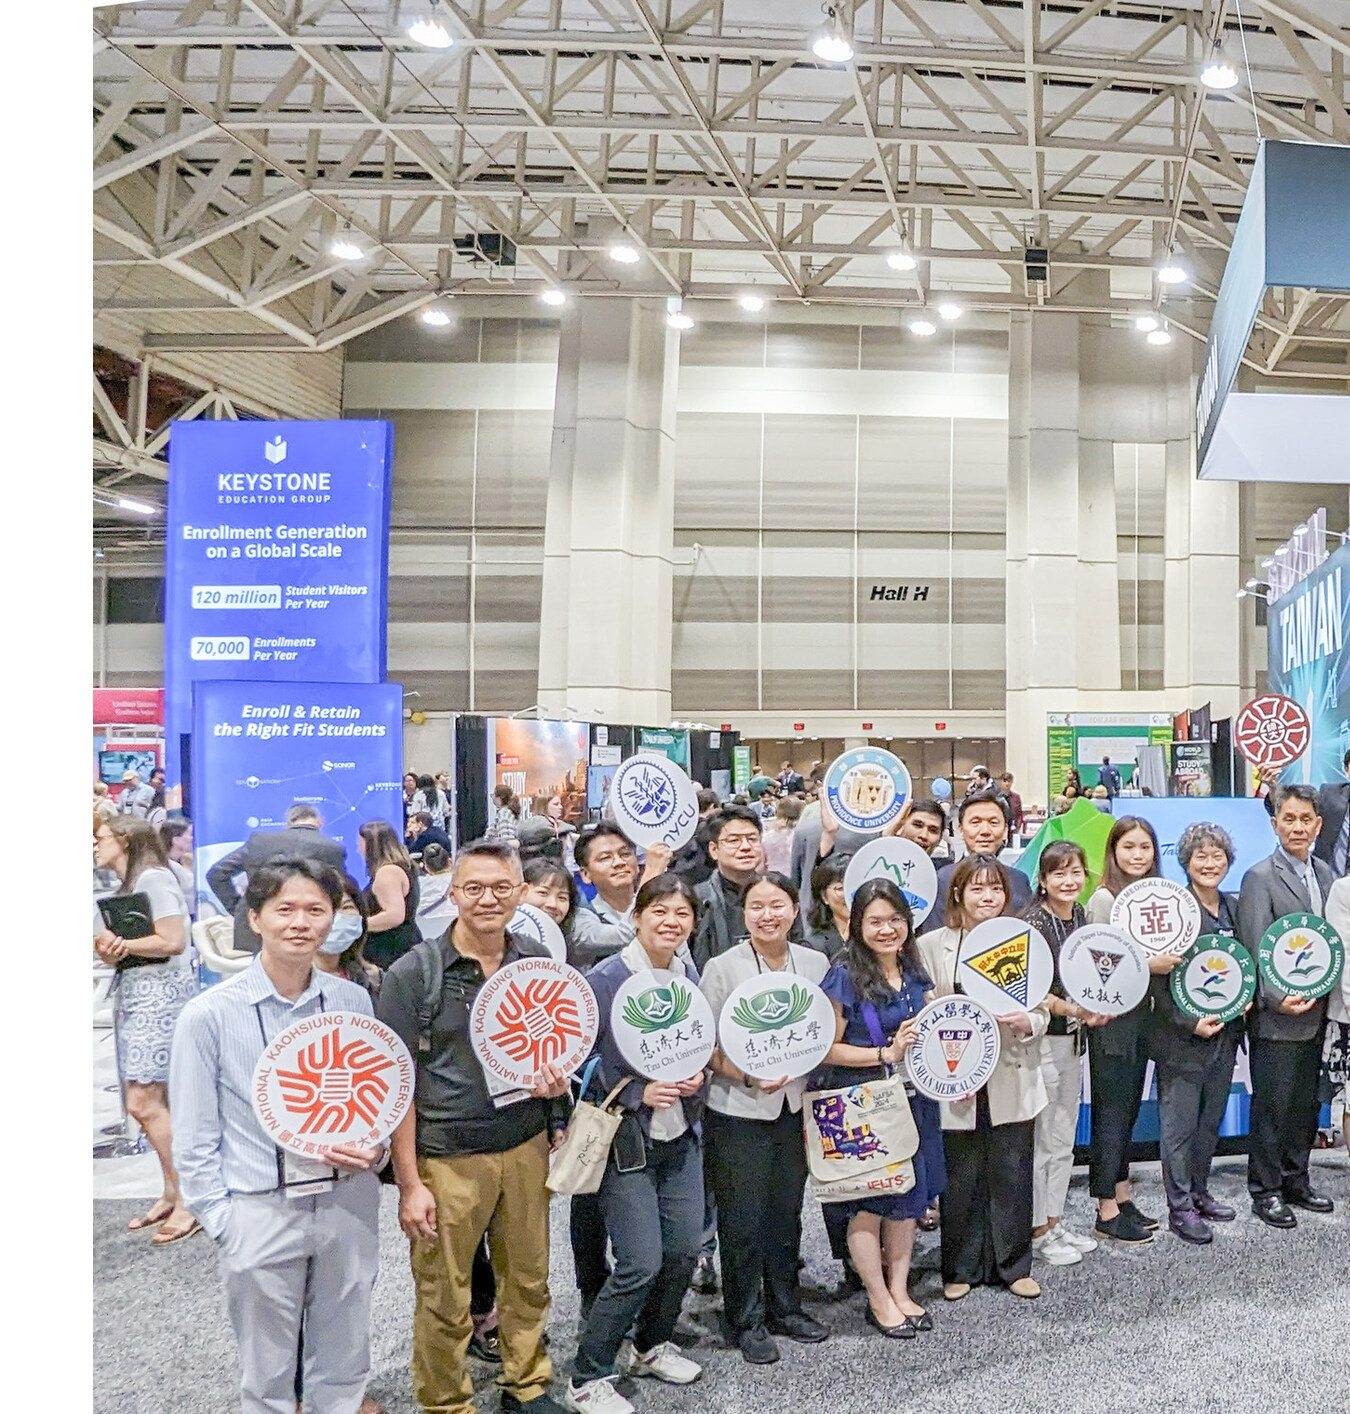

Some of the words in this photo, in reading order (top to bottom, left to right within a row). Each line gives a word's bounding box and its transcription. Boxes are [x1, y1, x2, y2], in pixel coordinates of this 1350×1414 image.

[218, 473, 331, 491] KEYSTONE
[218, 495, 285, 504] EDUCATION
[291, 495, 331, 504] GROUP
[183, 526, 272, 540] Enrollment
[276, 525, 368, 540] Generation
[206, 547, 228, 558] on
[231, 547, 242, 558] a
[245, 544, 297, 558] Global
[300, 543, 342, 558] Scale
[196, 591, 221, 605] 120
[225, 590, 278, 605] million
[286, 585, 327, 596] Student
[329, 585, 368, 596] Visitors
[870, 585, 909, 601] Hall
[913, 586, 929, 601] H
[286, 599, 302, 609] Per
[304, 598, 329, 609] Year
[1280, 567, 1342, 674] TAIWAN
[196, 641, 245, 657] 70,000
[254, 637, 316, 648] Enrollments
[254, 651, 270, 661] Per
[273, 650, 298, 661] Year
[242, 705, 290, 719] Enroll
[294, 706, 306, 718] &
[310, 705, 361, 719] Retain
[214, 723, 243, 737] the
[246, 723, 291, 739] Right
[293, 723, 314, 737] Fit
[318, 723, 386, 738] Students
[1177, 760, 1200, 768] STUDY
[830, 795, 863, 827] PROVIDENCE
[864, 800, 902, 827] UNIVERSITY
[1113, 898, 1125, 922] TAIPEI
[1123, 881, 1158, 898] MEDICAL
[1161, 881, 1197, 914] UNIVERSITY
[516, 961, 563, 974] NORMAL
[1264, 964, 1288, 994] NATIONAL
[1289, 989, 1310, 997] DONG
[1324, 950, 1342, 986] UNIVERSITY
[475, 970, 513, 1033] KAOHSIUNG
[567, 970, 595, 1031] UNIVERSITY
[1082, 987, 1124, 1006] 北教大
[1186, 1004, 1204, 1017] DONG
[1221, 988, 1250, 1018] UNIVERSITY
[267, 1015, 344, 1061] KAOHSIUNG
[350, 1016, 395, 1051] NORMAL
[478, 1038, 519, 1082] NATIONAL
[644, 1062, 661, 1073] Tzu
[661, 1056, 675, 1069] Chi
[676, 1041, 712, 1064] University
[747, 1060, 766, 1072] Tzu
[766, 1055, 782, 1067] Chi
[784, 1042, 829, 1062] University
[915, 1065, 932, 1089] SHAN
[934, 1081, 971, 1095] MEDICAL
[972, 1033, 995, 1085] UNIVERSITY
[256, 1066, 281, 1131] NATIONAL
[384, 1054, 410, 1128] UNIVERSITY
[278, 1127, 382, 1154] 國立高雄範大學
[867, 1175, 904, 1191] IELTS
